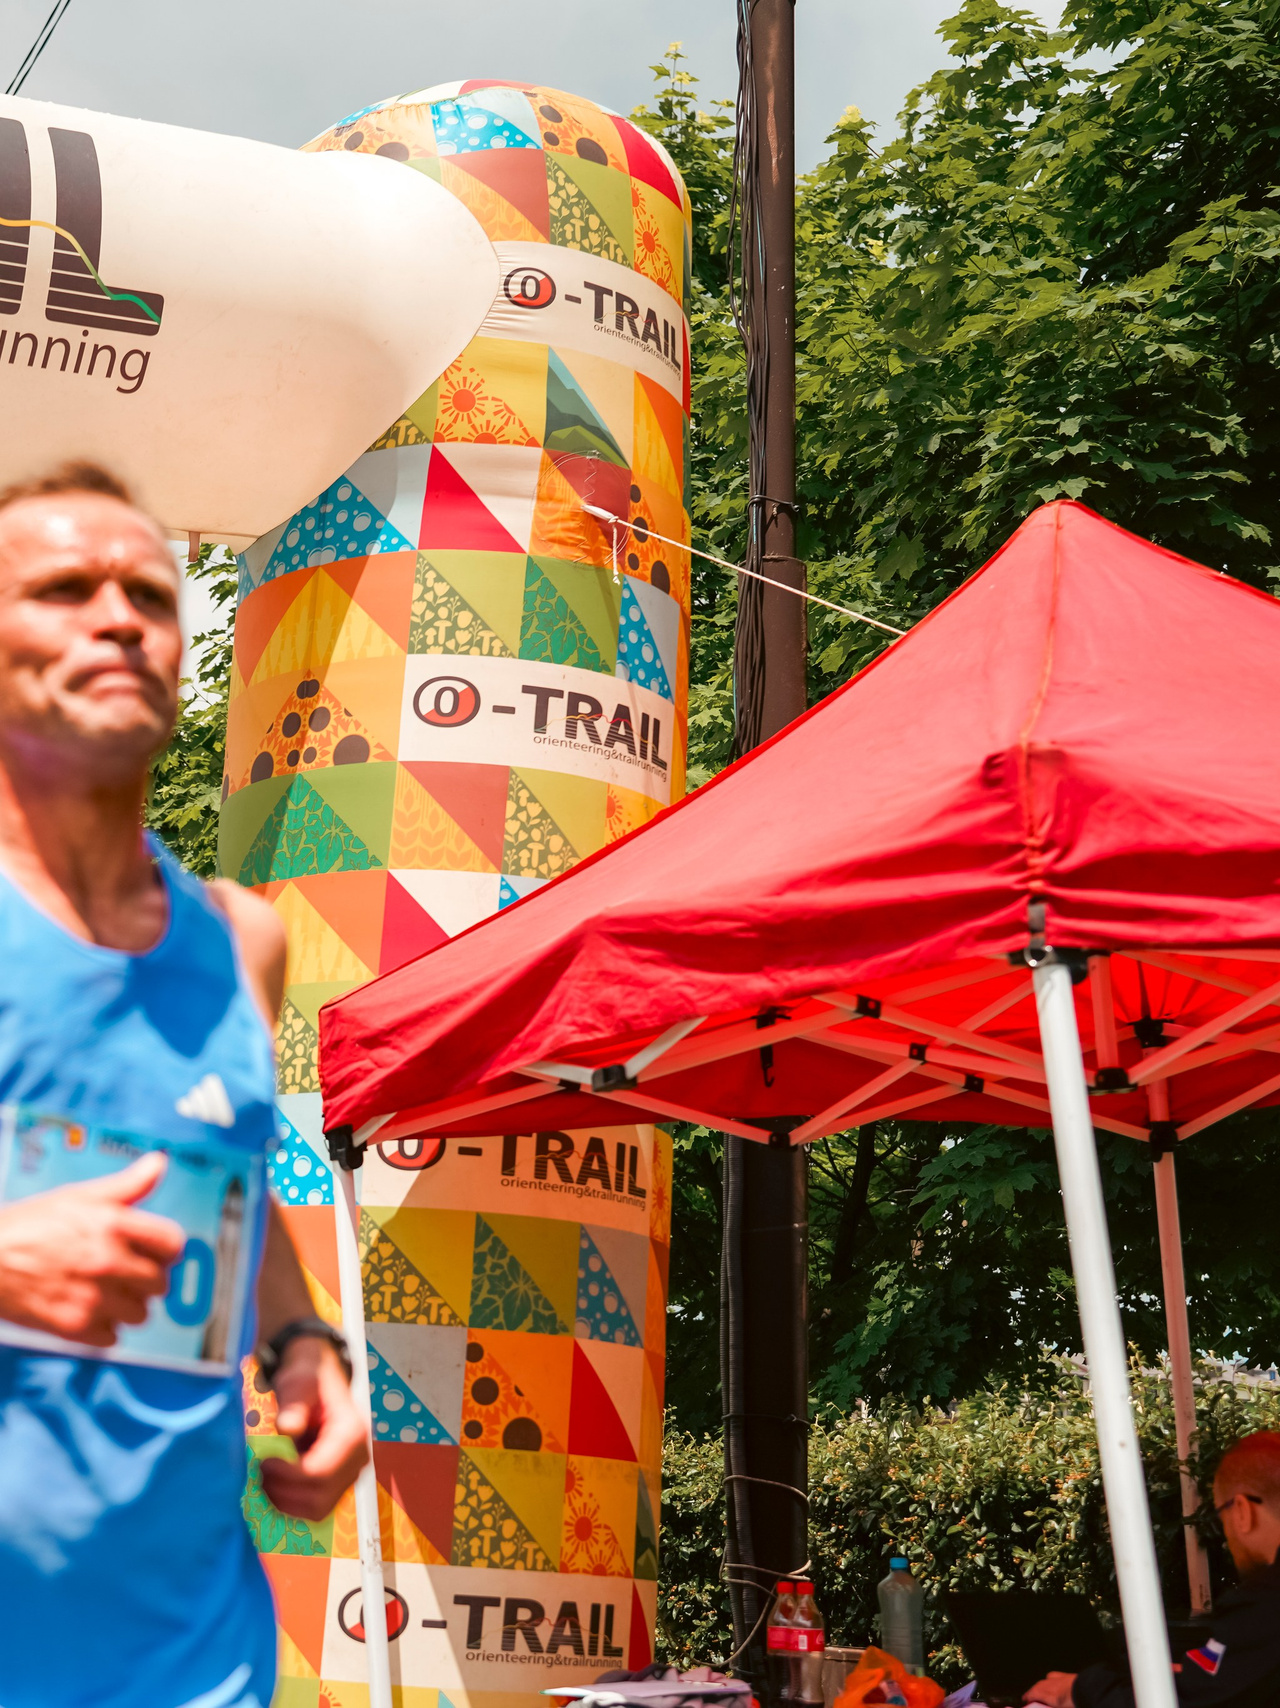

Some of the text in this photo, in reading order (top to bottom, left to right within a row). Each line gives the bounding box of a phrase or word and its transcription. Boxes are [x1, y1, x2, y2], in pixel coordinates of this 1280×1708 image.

[412, 675, 668, 772] O-TRAIL
[533, 735, 668, 783] orienteering&trailrunning
[500, 1176, 646, 1212] orienteering&trailrunning
[465, 1649, 623, 1669] orienteering&trailrunning
